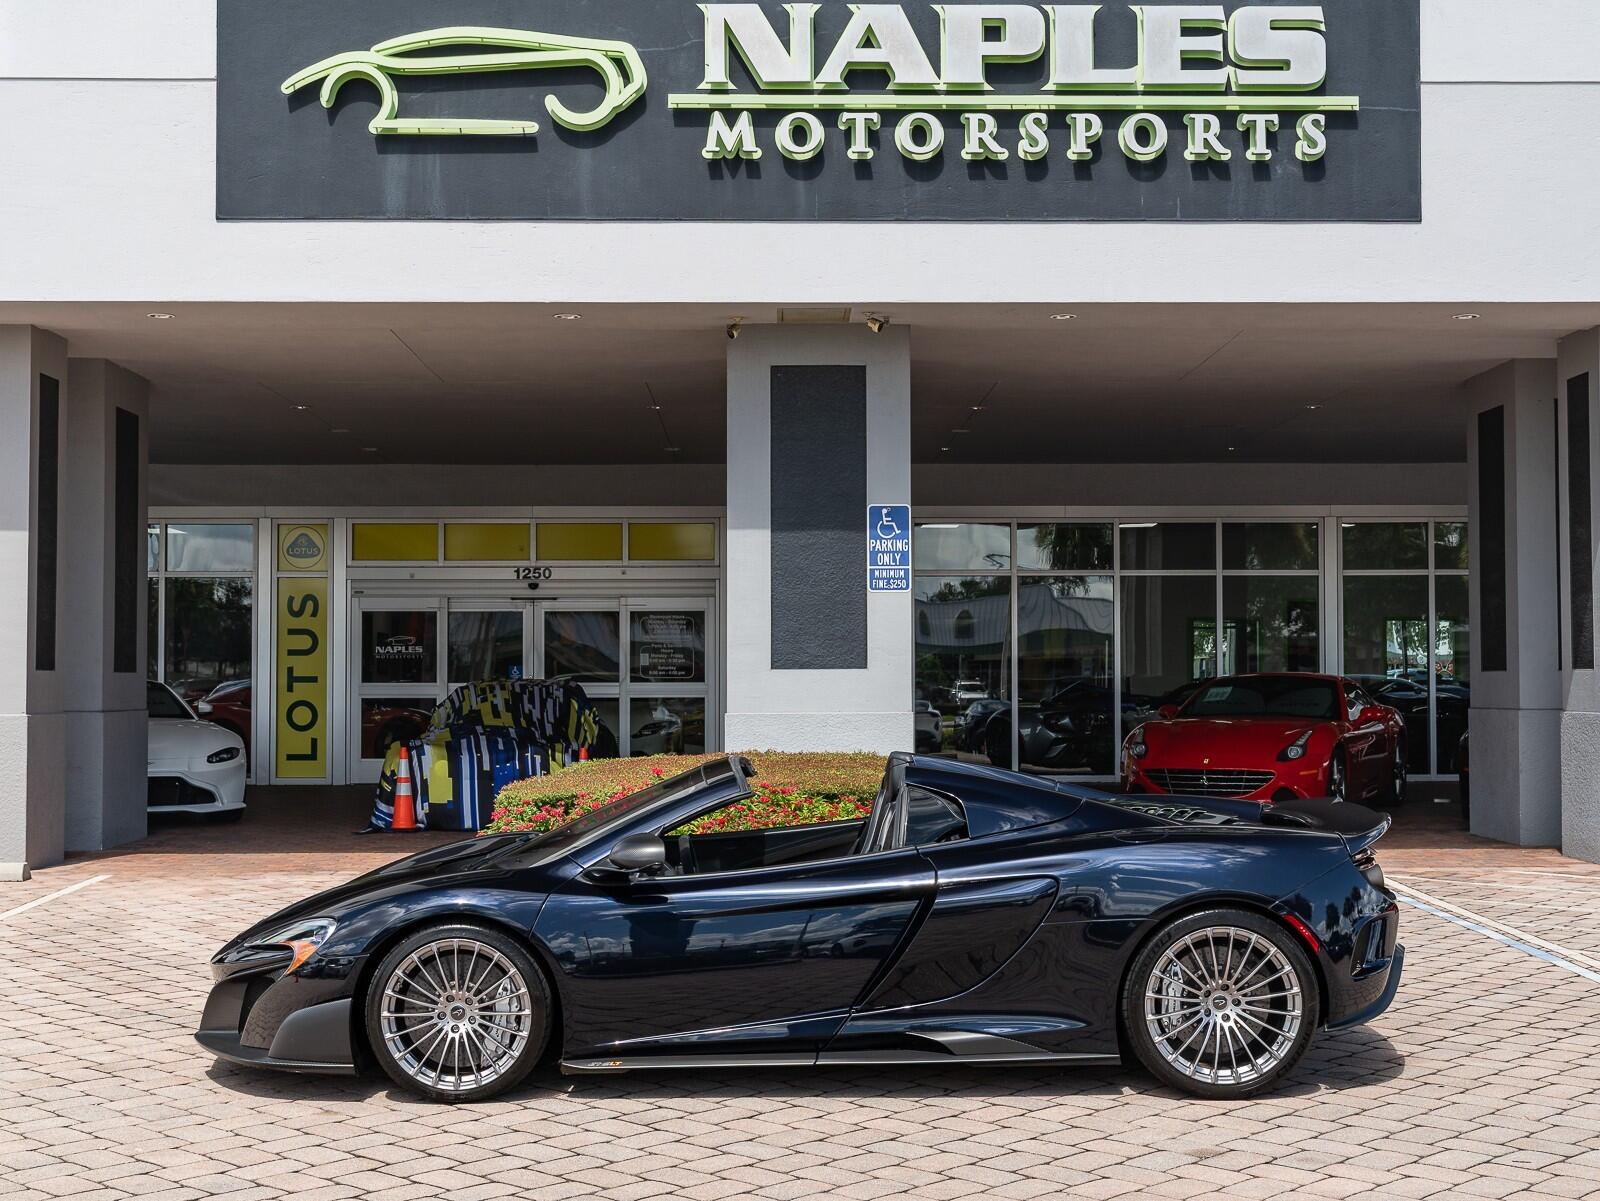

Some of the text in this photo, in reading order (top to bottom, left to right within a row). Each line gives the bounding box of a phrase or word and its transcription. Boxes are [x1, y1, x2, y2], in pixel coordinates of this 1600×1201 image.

[696, 3, 1328, 91] NAPLES
[701, 111, 1327, 162] MOTORSPORTS
[288, 546, 319, 555] LOTUS
[870, 540, 908, 551] PARKING
[877, 553, 901, 565] ONLY
[513, 567, 552, 579] 1250
[874, 570, 904, 578] MINIMUM
[375, 645, 423, 654] NAPLES
[285, 593, 320, 762] LOTUS
